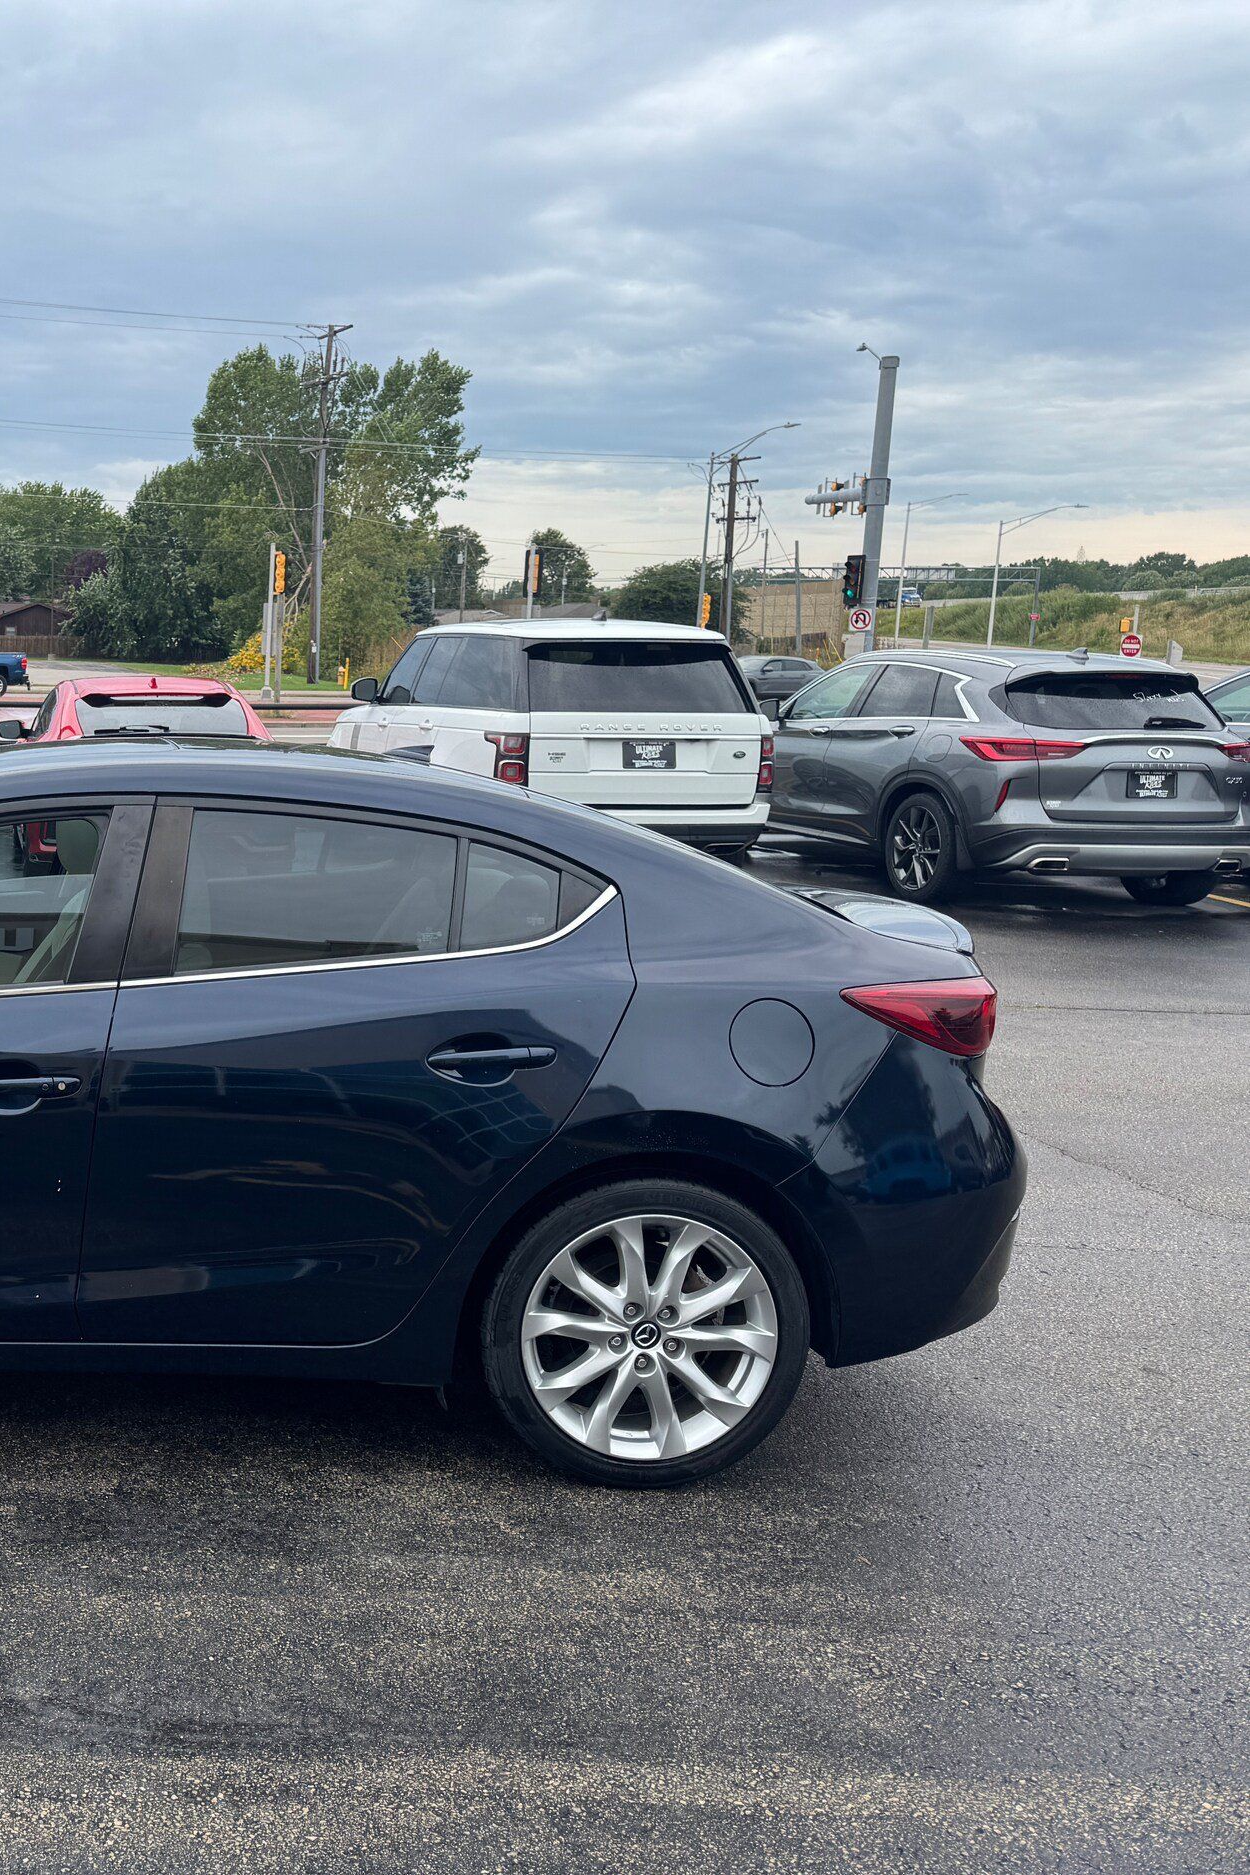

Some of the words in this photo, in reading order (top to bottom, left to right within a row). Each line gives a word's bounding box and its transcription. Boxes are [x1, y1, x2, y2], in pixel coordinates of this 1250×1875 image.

[580, 723, 646, 732] RANGE
[659, 724, 723, 732] ROVER
[635, 745, 664, 755] ULTIMATE
[1139, 774, 1166, 785] ULTIMATE
